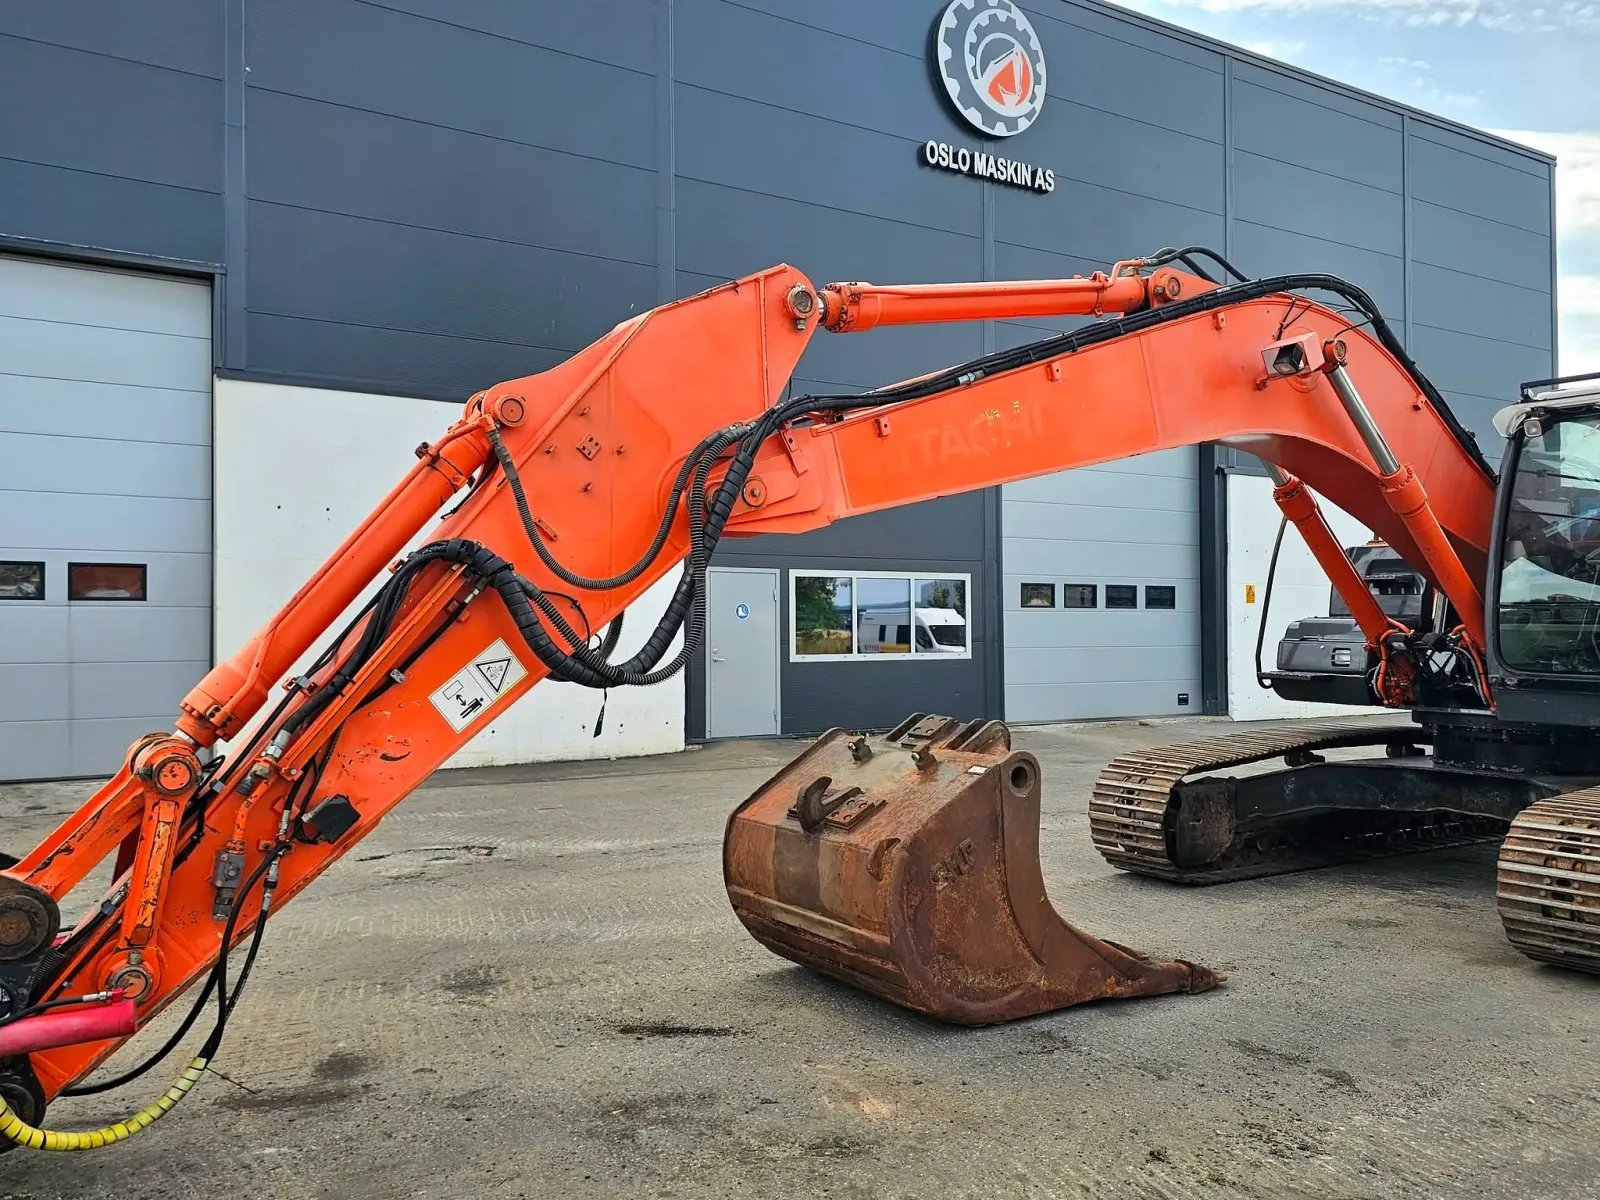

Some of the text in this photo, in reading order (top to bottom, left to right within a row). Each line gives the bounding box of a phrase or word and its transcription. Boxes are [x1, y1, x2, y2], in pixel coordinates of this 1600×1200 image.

[925, 140, 1055, 192] OSLO MASKIN AS
[882, 402, 1045, 477] ITACHI
